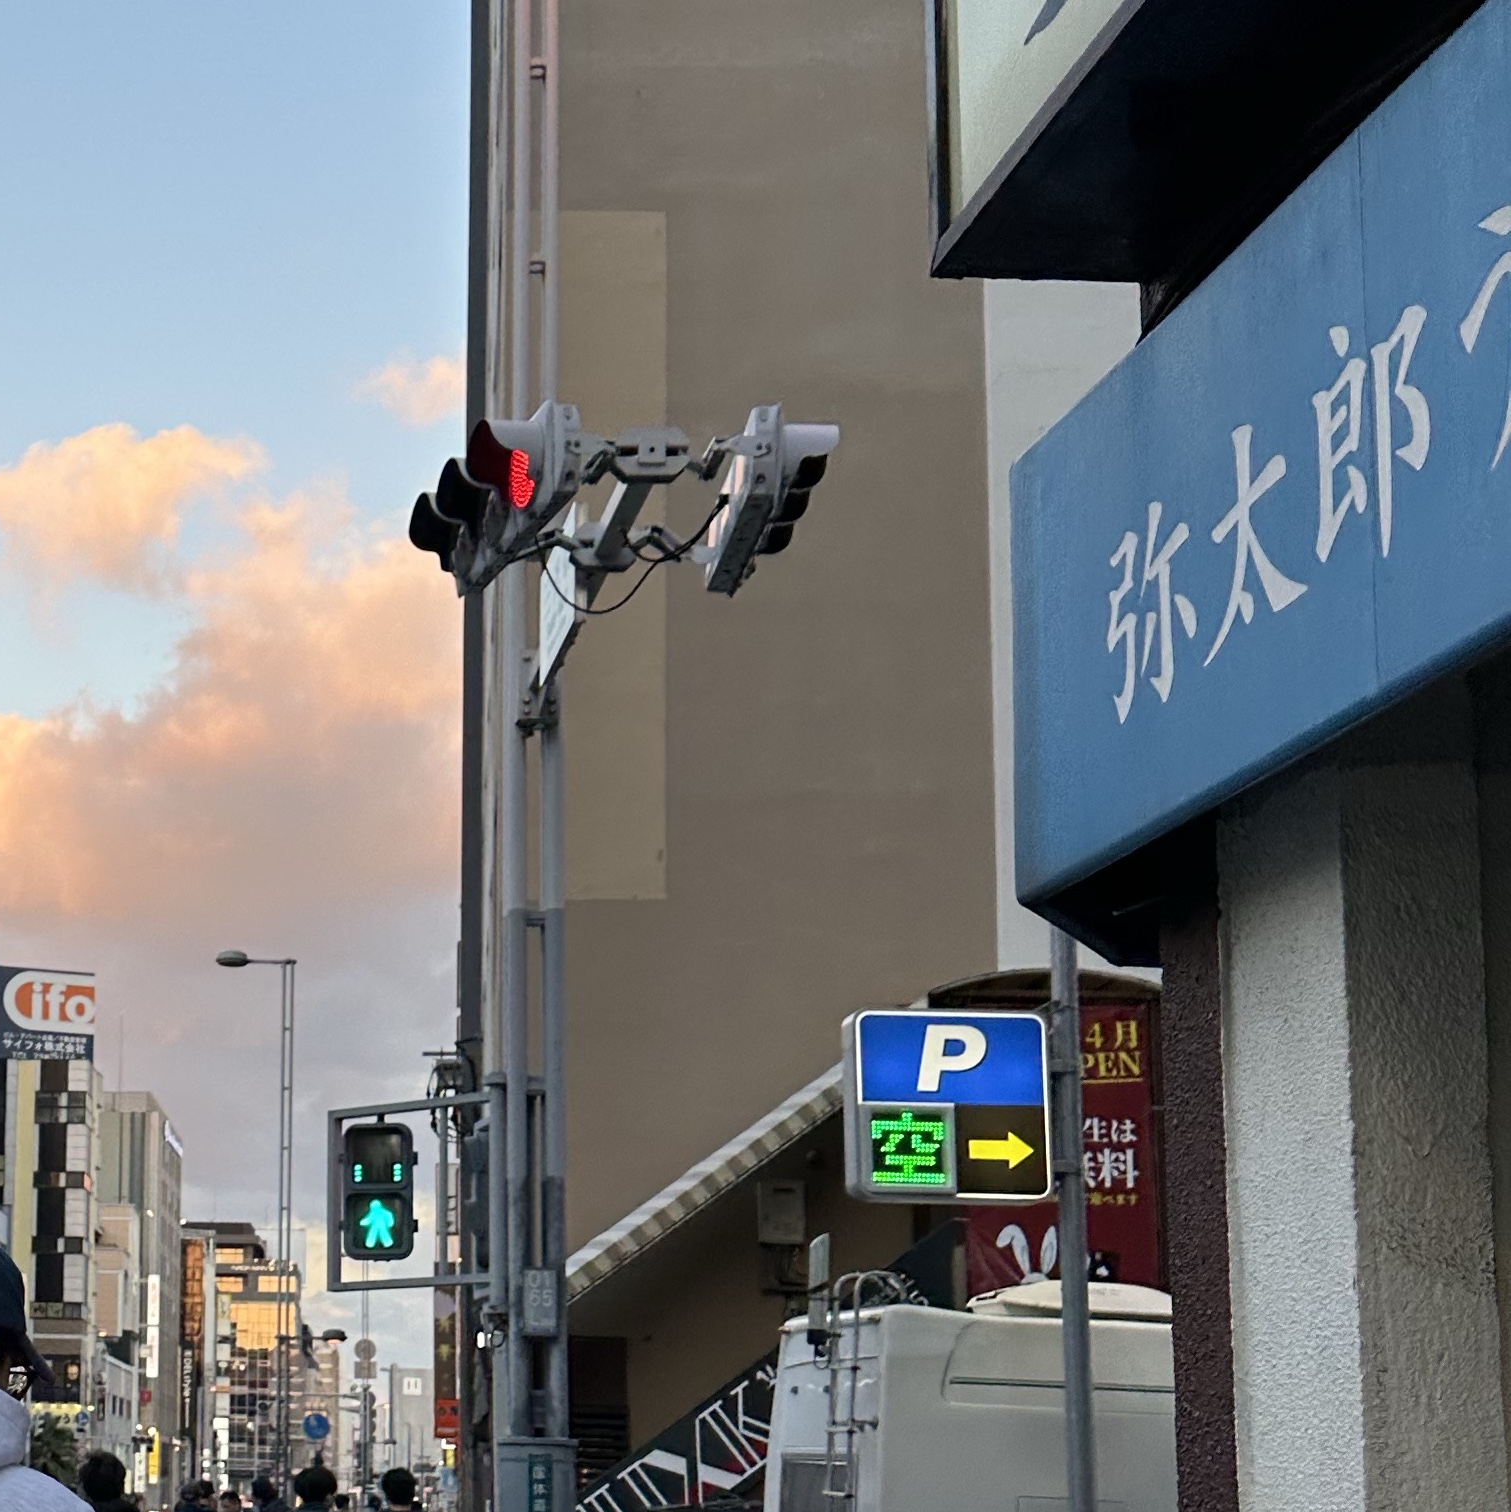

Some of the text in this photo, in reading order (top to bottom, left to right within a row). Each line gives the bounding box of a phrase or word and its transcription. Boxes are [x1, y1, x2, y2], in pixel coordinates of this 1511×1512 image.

[1107, 205, 1511, 725] 弥太郎
[916, 1023, 987, 1093] P
[1079, 1051, 1142, 1078] PEN
[870, 1111, 946, 1186] 空
